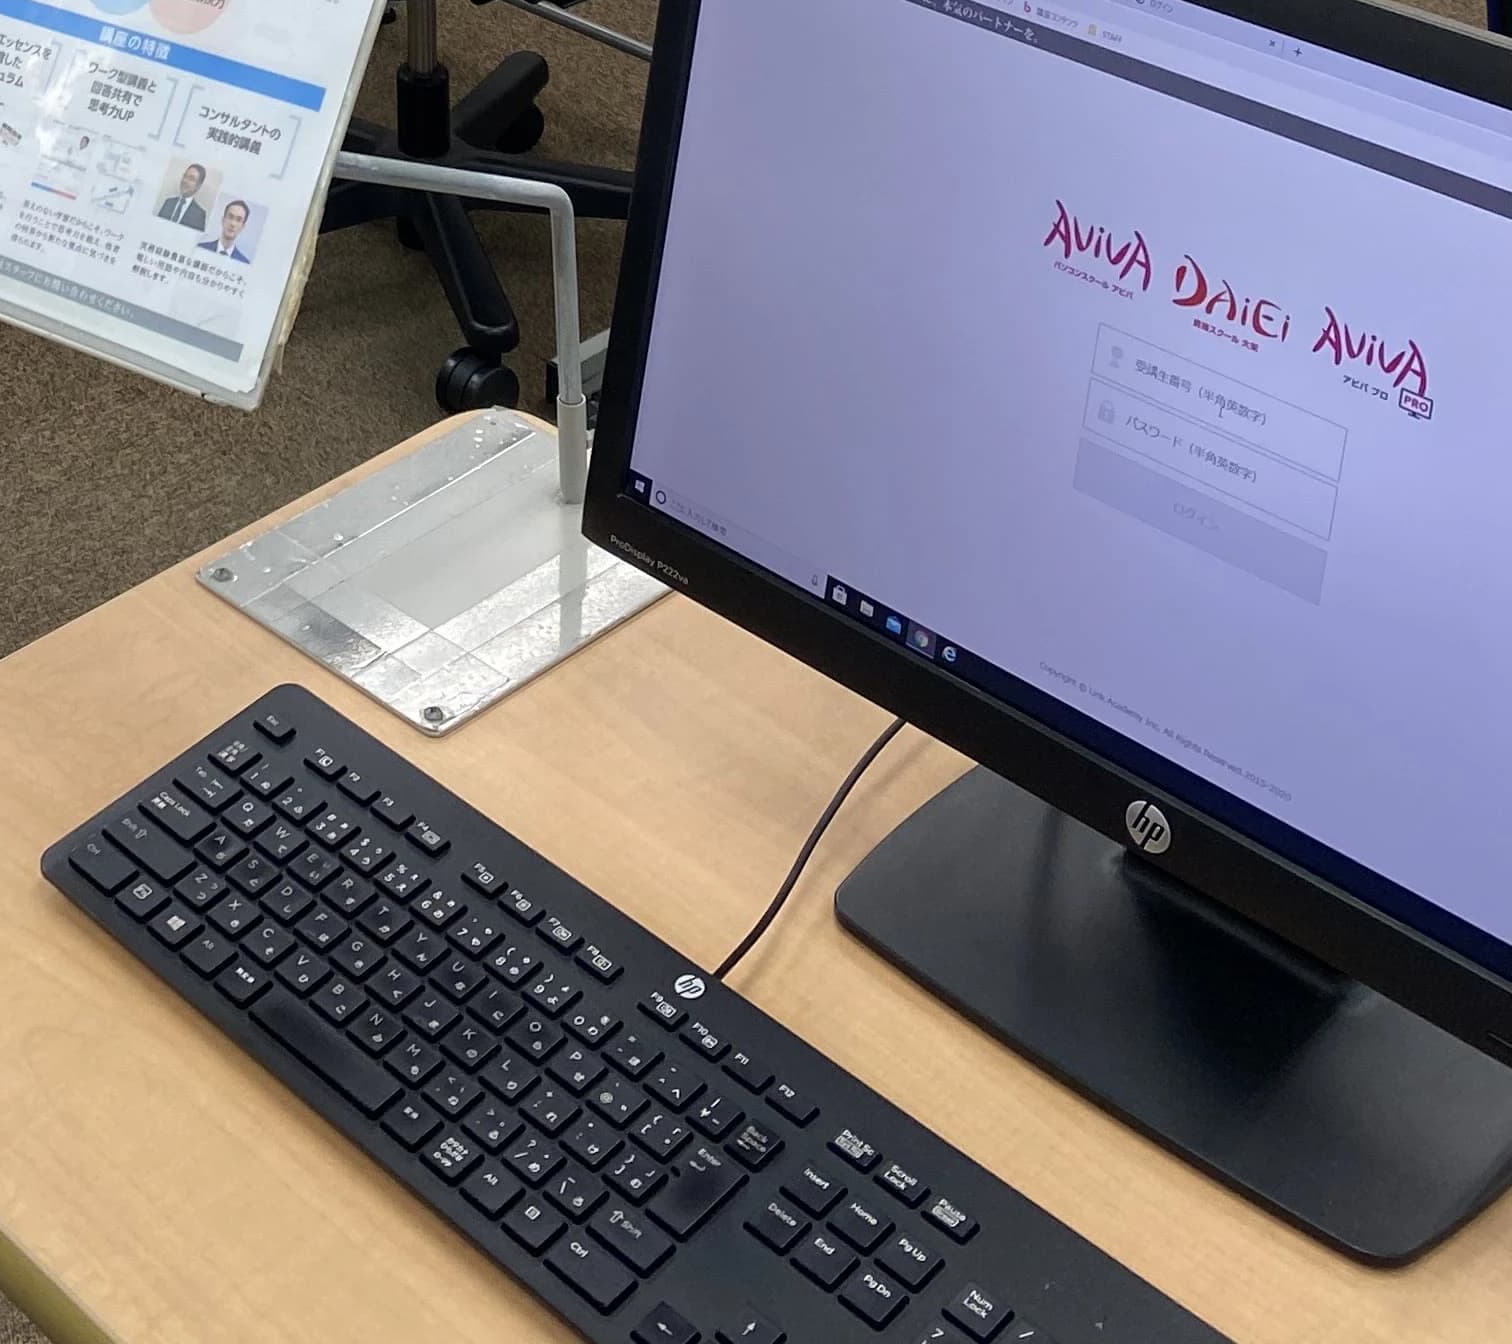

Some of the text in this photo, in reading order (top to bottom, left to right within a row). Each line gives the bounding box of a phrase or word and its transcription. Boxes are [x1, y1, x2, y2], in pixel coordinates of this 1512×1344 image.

[99, 26, 171, 61] 講座の特徴
[88, 61, 157, 94] ワーク型講義と
[90, 80, 142, 108] 回答共有で
[88, 99, 135, 122] 思考力UP
[199, 105, 281, 141] コンサルタントの
[205, 126, 262, 155] 実践的講義
[1054, 261, 1134, 300] パソコンスクール アビバ
[1343, 375, 1389, 401] アビバ プロ
[1403, 394, 1429, 413] PRO
[1172, 503, 1220, 530] ログイン
[610, 534, 689, 585] ProDisplay P222va
[1039, 661, 1076, 687] Copyright
[1129, 801, 1168, 852] hp
[674, 974, 706, 999] hp
[696, 1147, 723, 1168] Enter
[483, 1172, 499, 1187] Alt
[803, 1167, 830, 1190] Insert
[884, 1171, 908, 1192] Lock
[890, 1164, 918, 1187] Scroll
[767, 1202, 797, 1227] Delete
[850, 1203, 878, 1226] Home
[569, 1241, 589, 1258] Ctrl
[814, 1237, 836, 1256] End
[963, 1297, 988, 1319] Lock
[969, 1289, 993, 1312] Num
